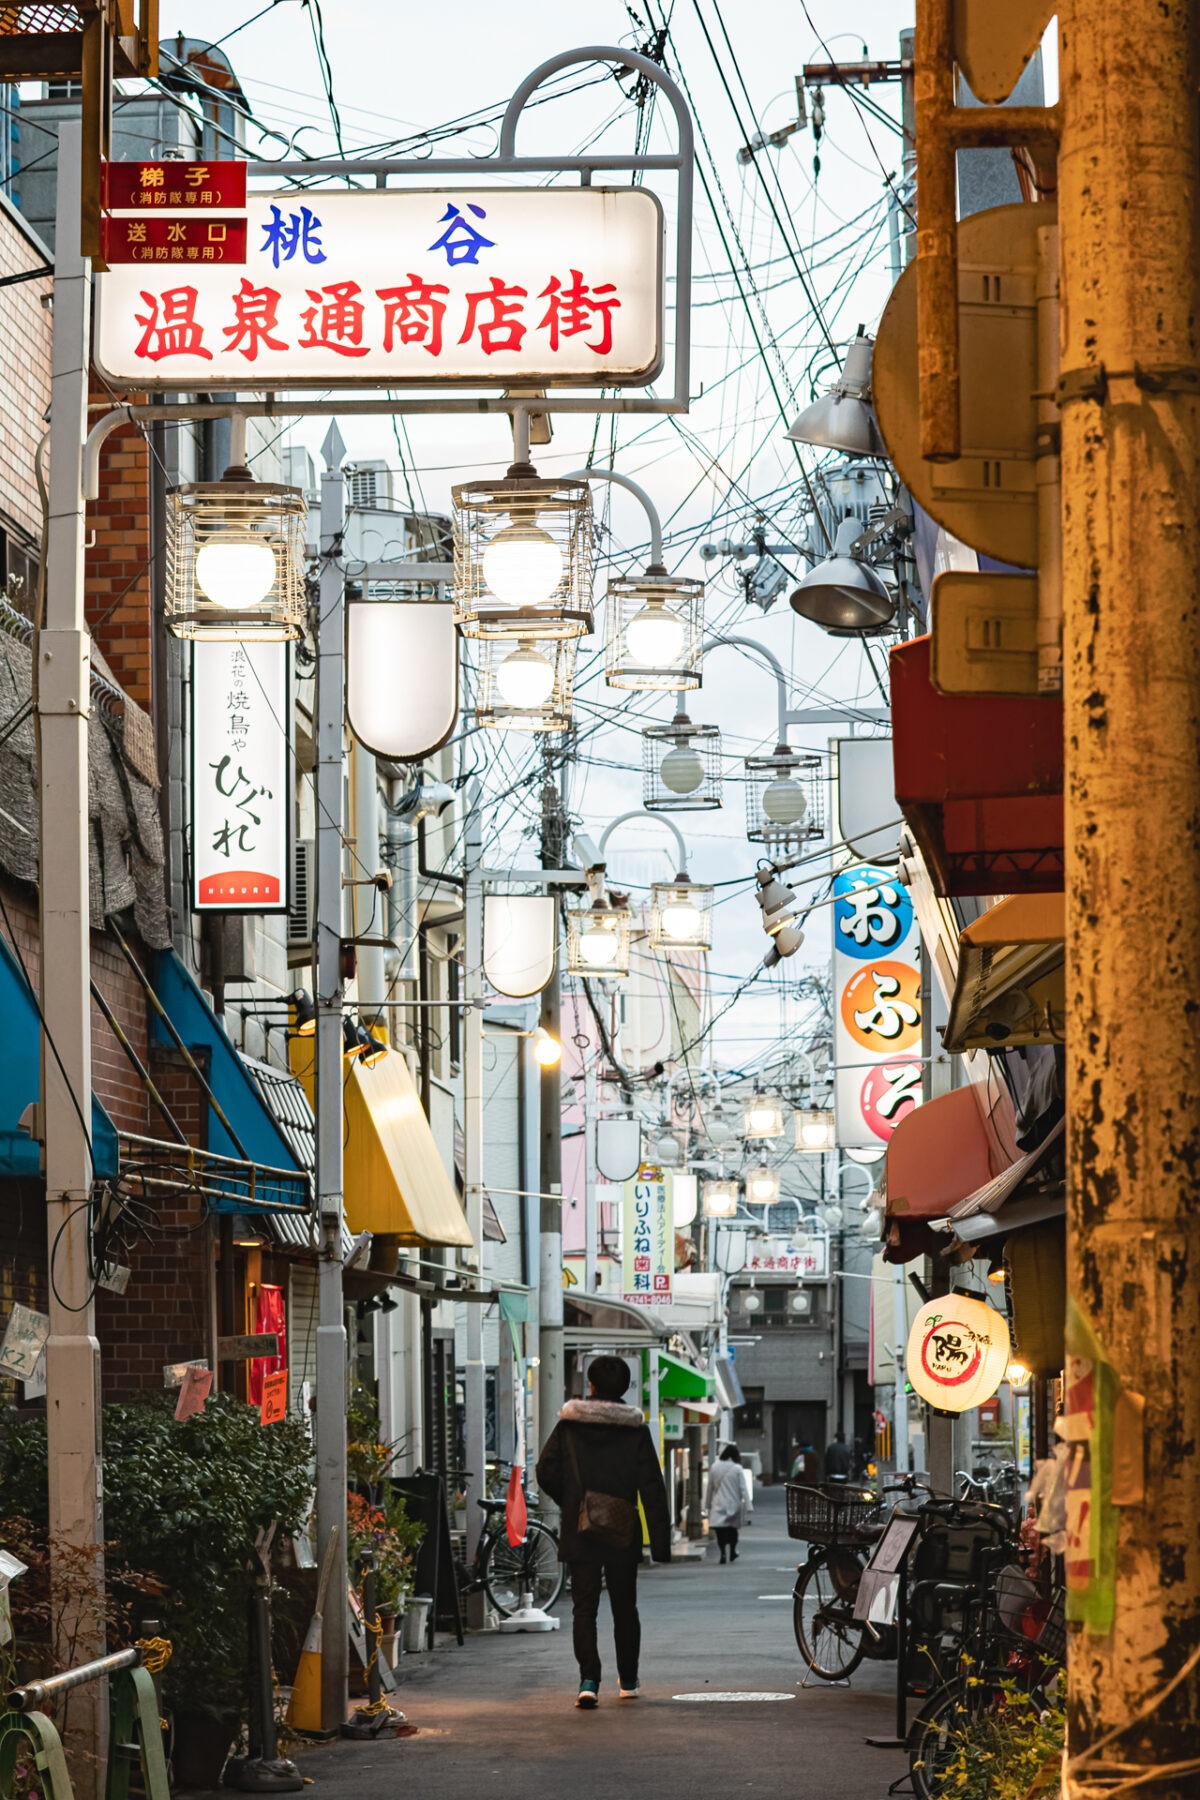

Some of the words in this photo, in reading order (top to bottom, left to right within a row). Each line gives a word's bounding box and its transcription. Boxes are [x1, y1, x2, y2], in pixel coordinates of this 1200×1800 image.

[139, 167, 210, 187] 梯子
[127, 222, 227, 242] 送水口
[260, 202, 497, 269] 桃谷
[134, 268, 621, 362] 温泉通商店街
[226, 649, 251, 752] 浪花の焼鳥や
[208, 754, 273, 858] ひぐれ
[208, 886, 270, 895] HIGURE
[633, 1185, 651, 1290] いりふね歯科
[743, 1256, 817, 1270] 泉通商店街
